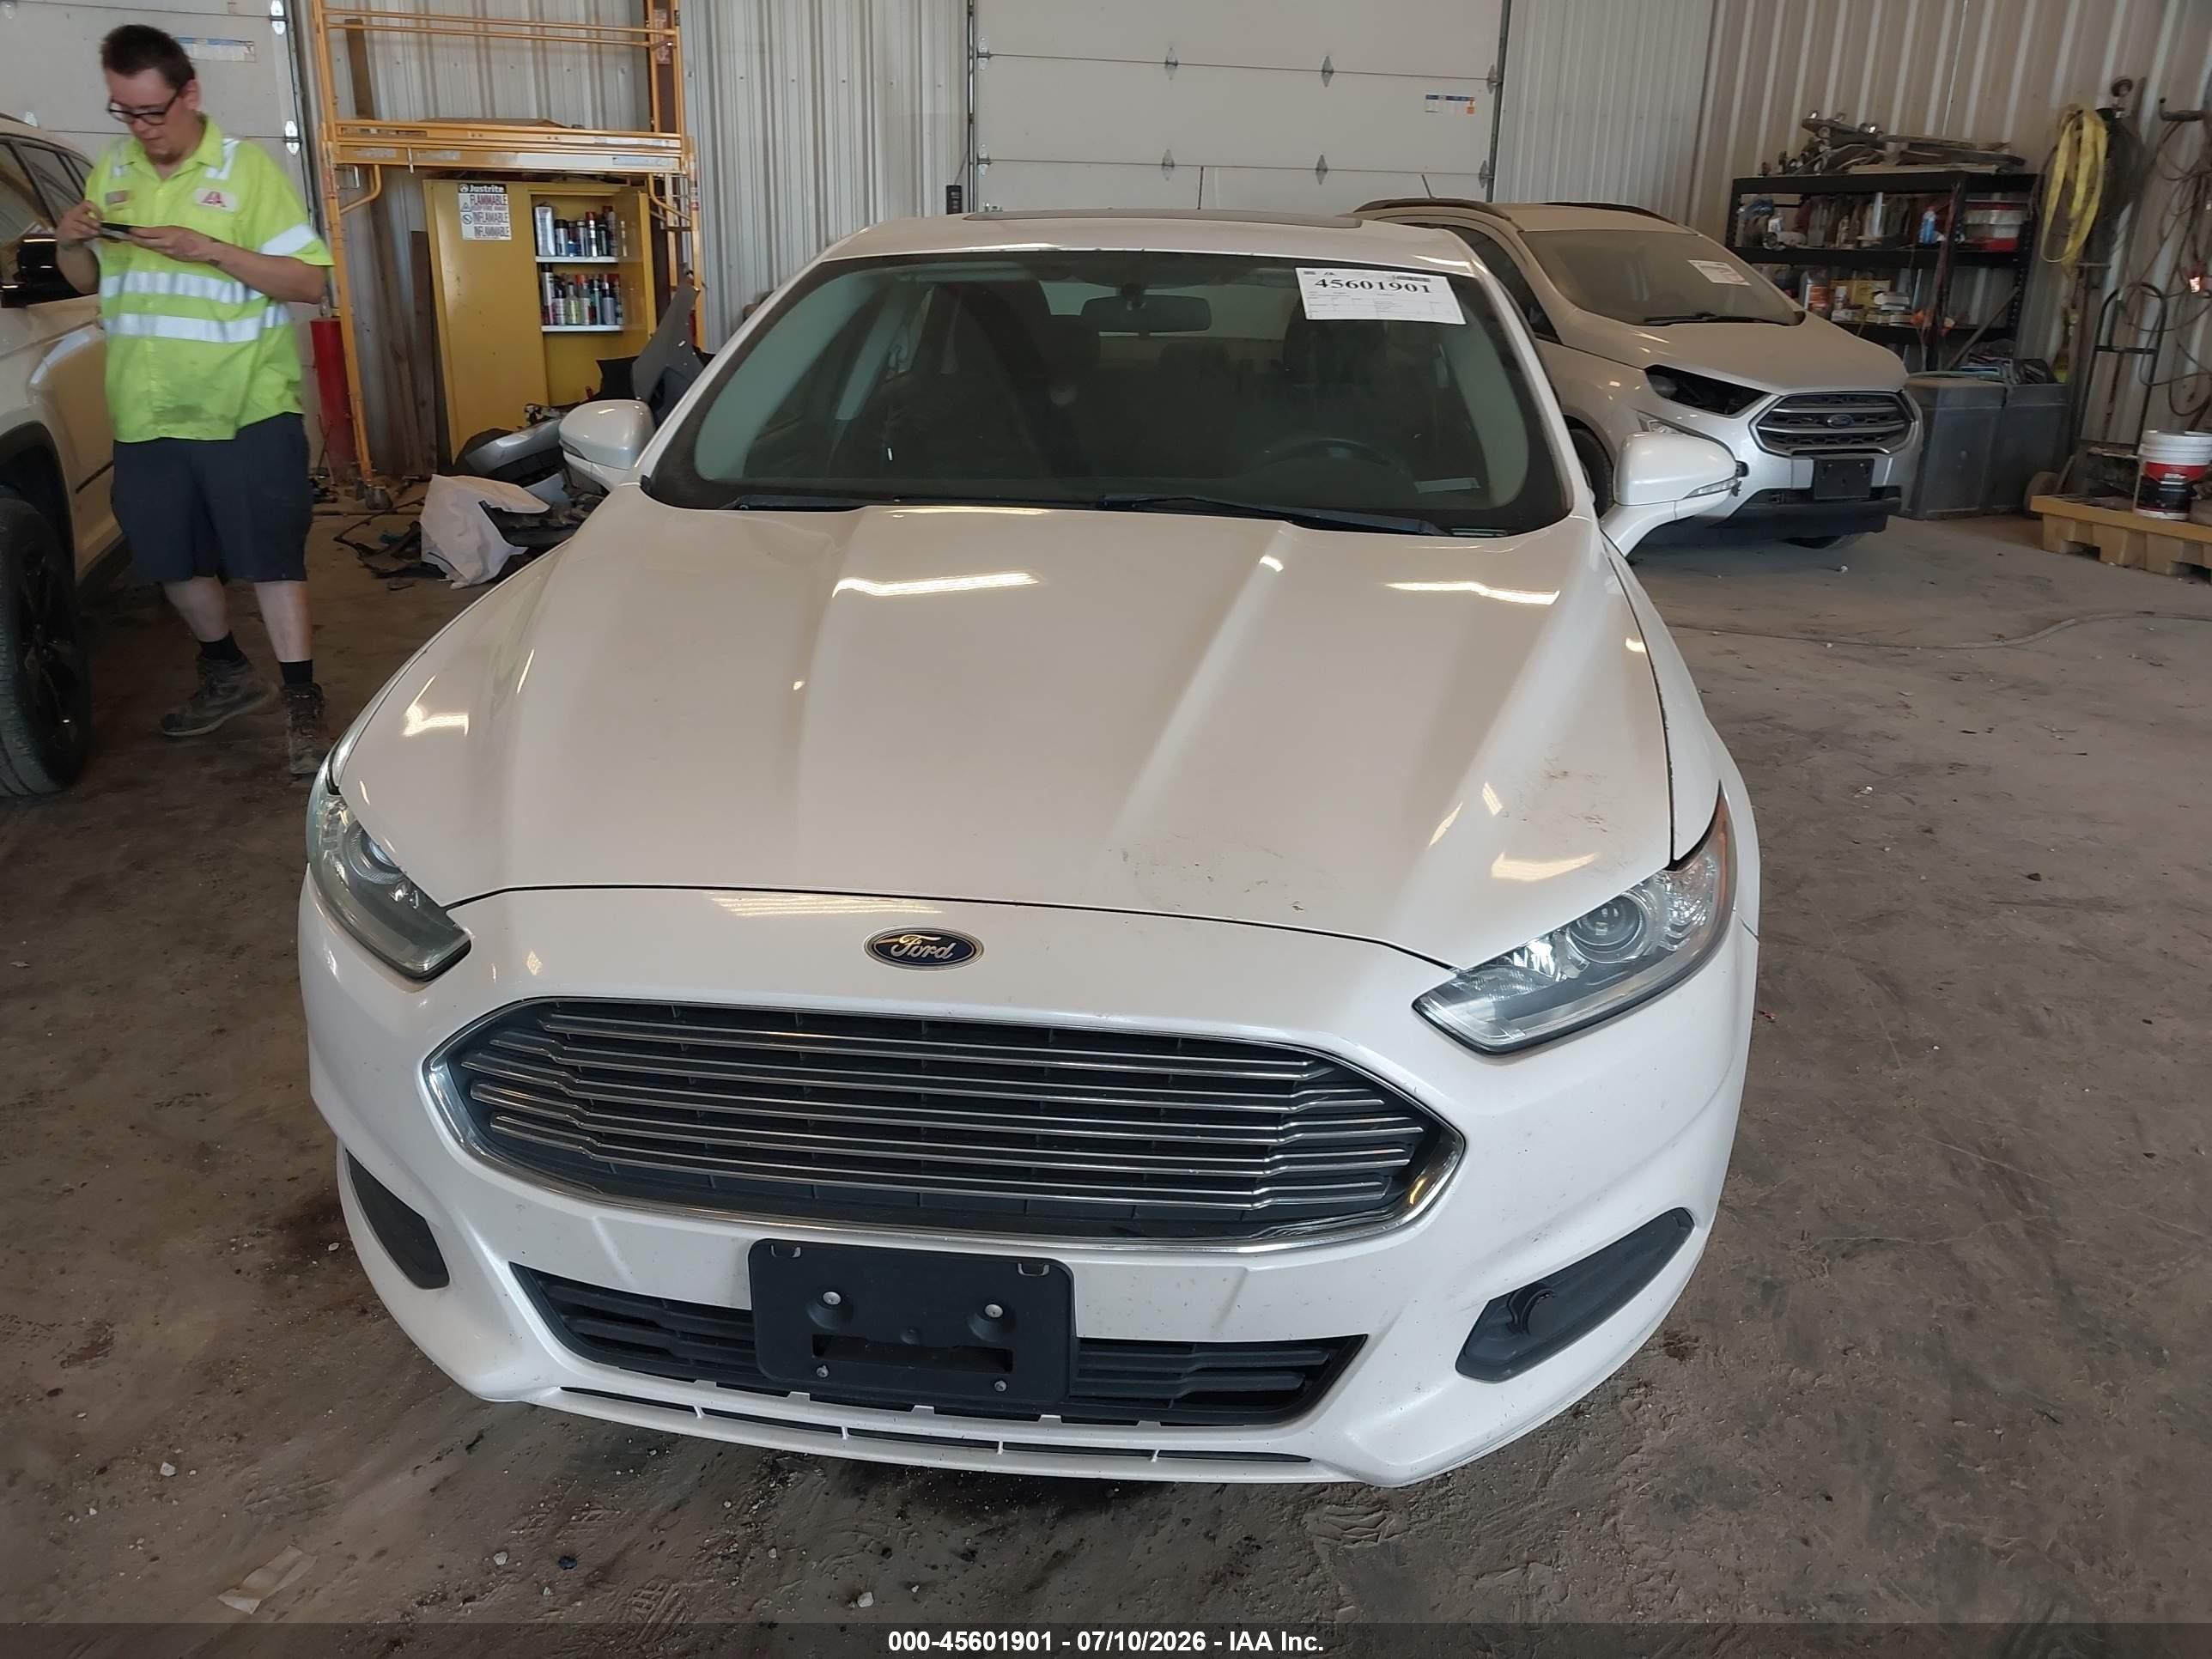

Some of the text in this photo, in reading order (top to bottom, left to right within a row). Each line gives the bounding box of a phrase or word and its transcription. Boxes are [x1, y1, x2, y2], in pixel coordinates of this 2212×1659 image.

[469, 185, 506, 193] Justrite
[470, 194, 508, 206] FLAMMABLE
[1315, 278, 1431, 294] 45601901
[890, 933, 957, 960] Ford
